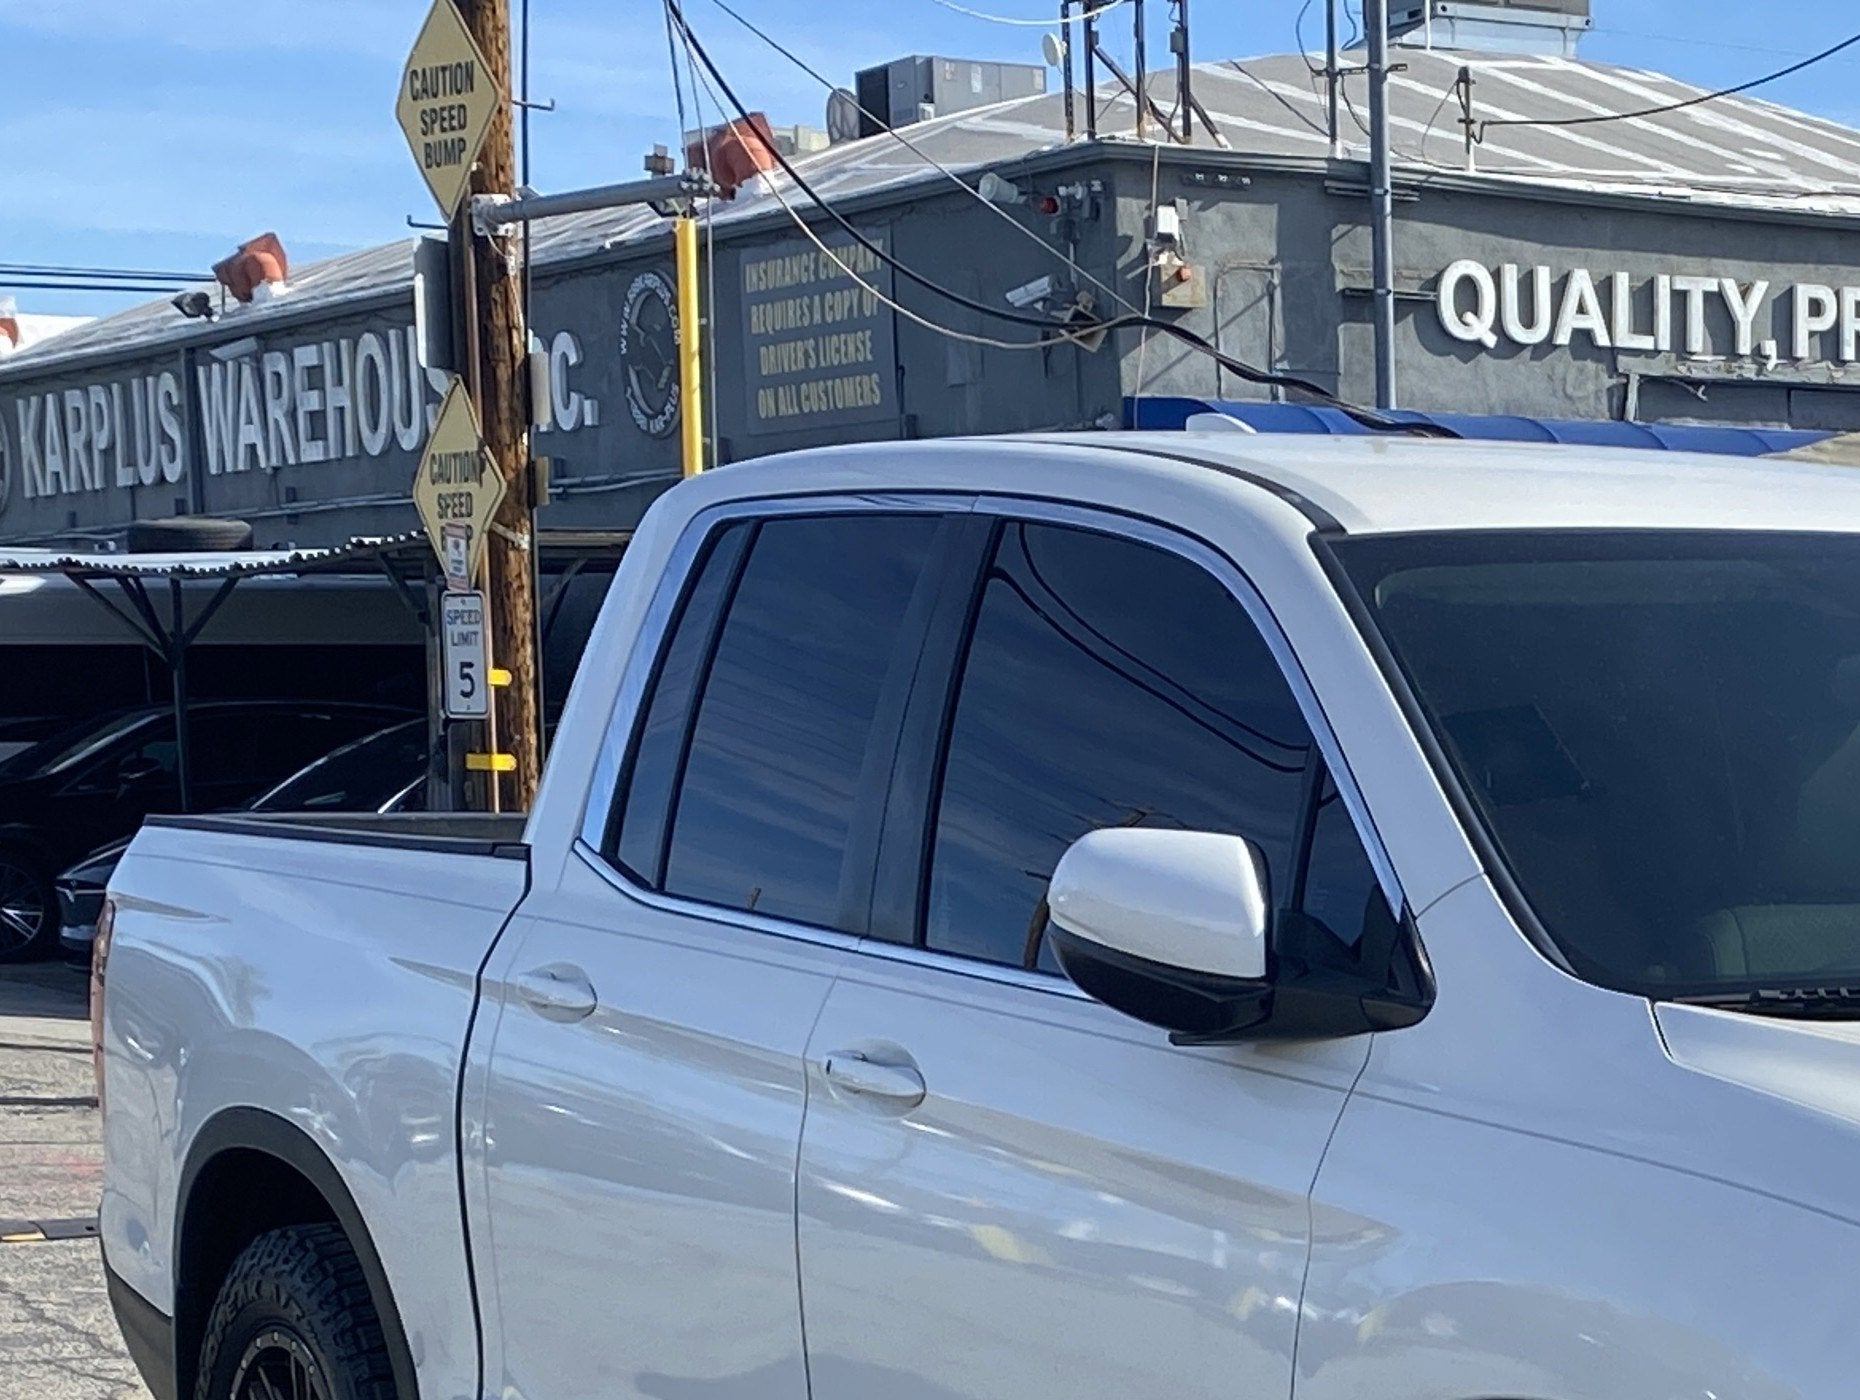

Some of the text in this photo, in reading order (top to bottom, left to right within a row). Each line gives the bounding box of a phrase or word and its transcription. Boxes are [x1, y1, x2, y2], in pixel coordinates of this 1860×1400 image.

[409, 60, 474, 102] CAUTION
[420, 104, 467, 136] SPEED
[424, 137, 467, 170] BUMP
[745, 240, 884, 293] INSURANCE COMPANY
[750, 295, 810, 335] REQUIRES
[812, 294, 822, 325] A
[824, 287, 860, 324] COPY
[1436, 258, 1778, 372] QUALITY,
[759, 331, 873, 375] DRIVER'S LICENSE
[757, 374, 881, 419] ON ALL CUSTOMERS
[16, 372, 185, 499] KARPLUS
[430, 451, 480, 486] CAUTION
[437, 491, 473, 519] SPEED
[446, 608, 482, 626] SPEED
[450, 630, 479, 647] LIMIT
[459, 661, 476, 699] 5
